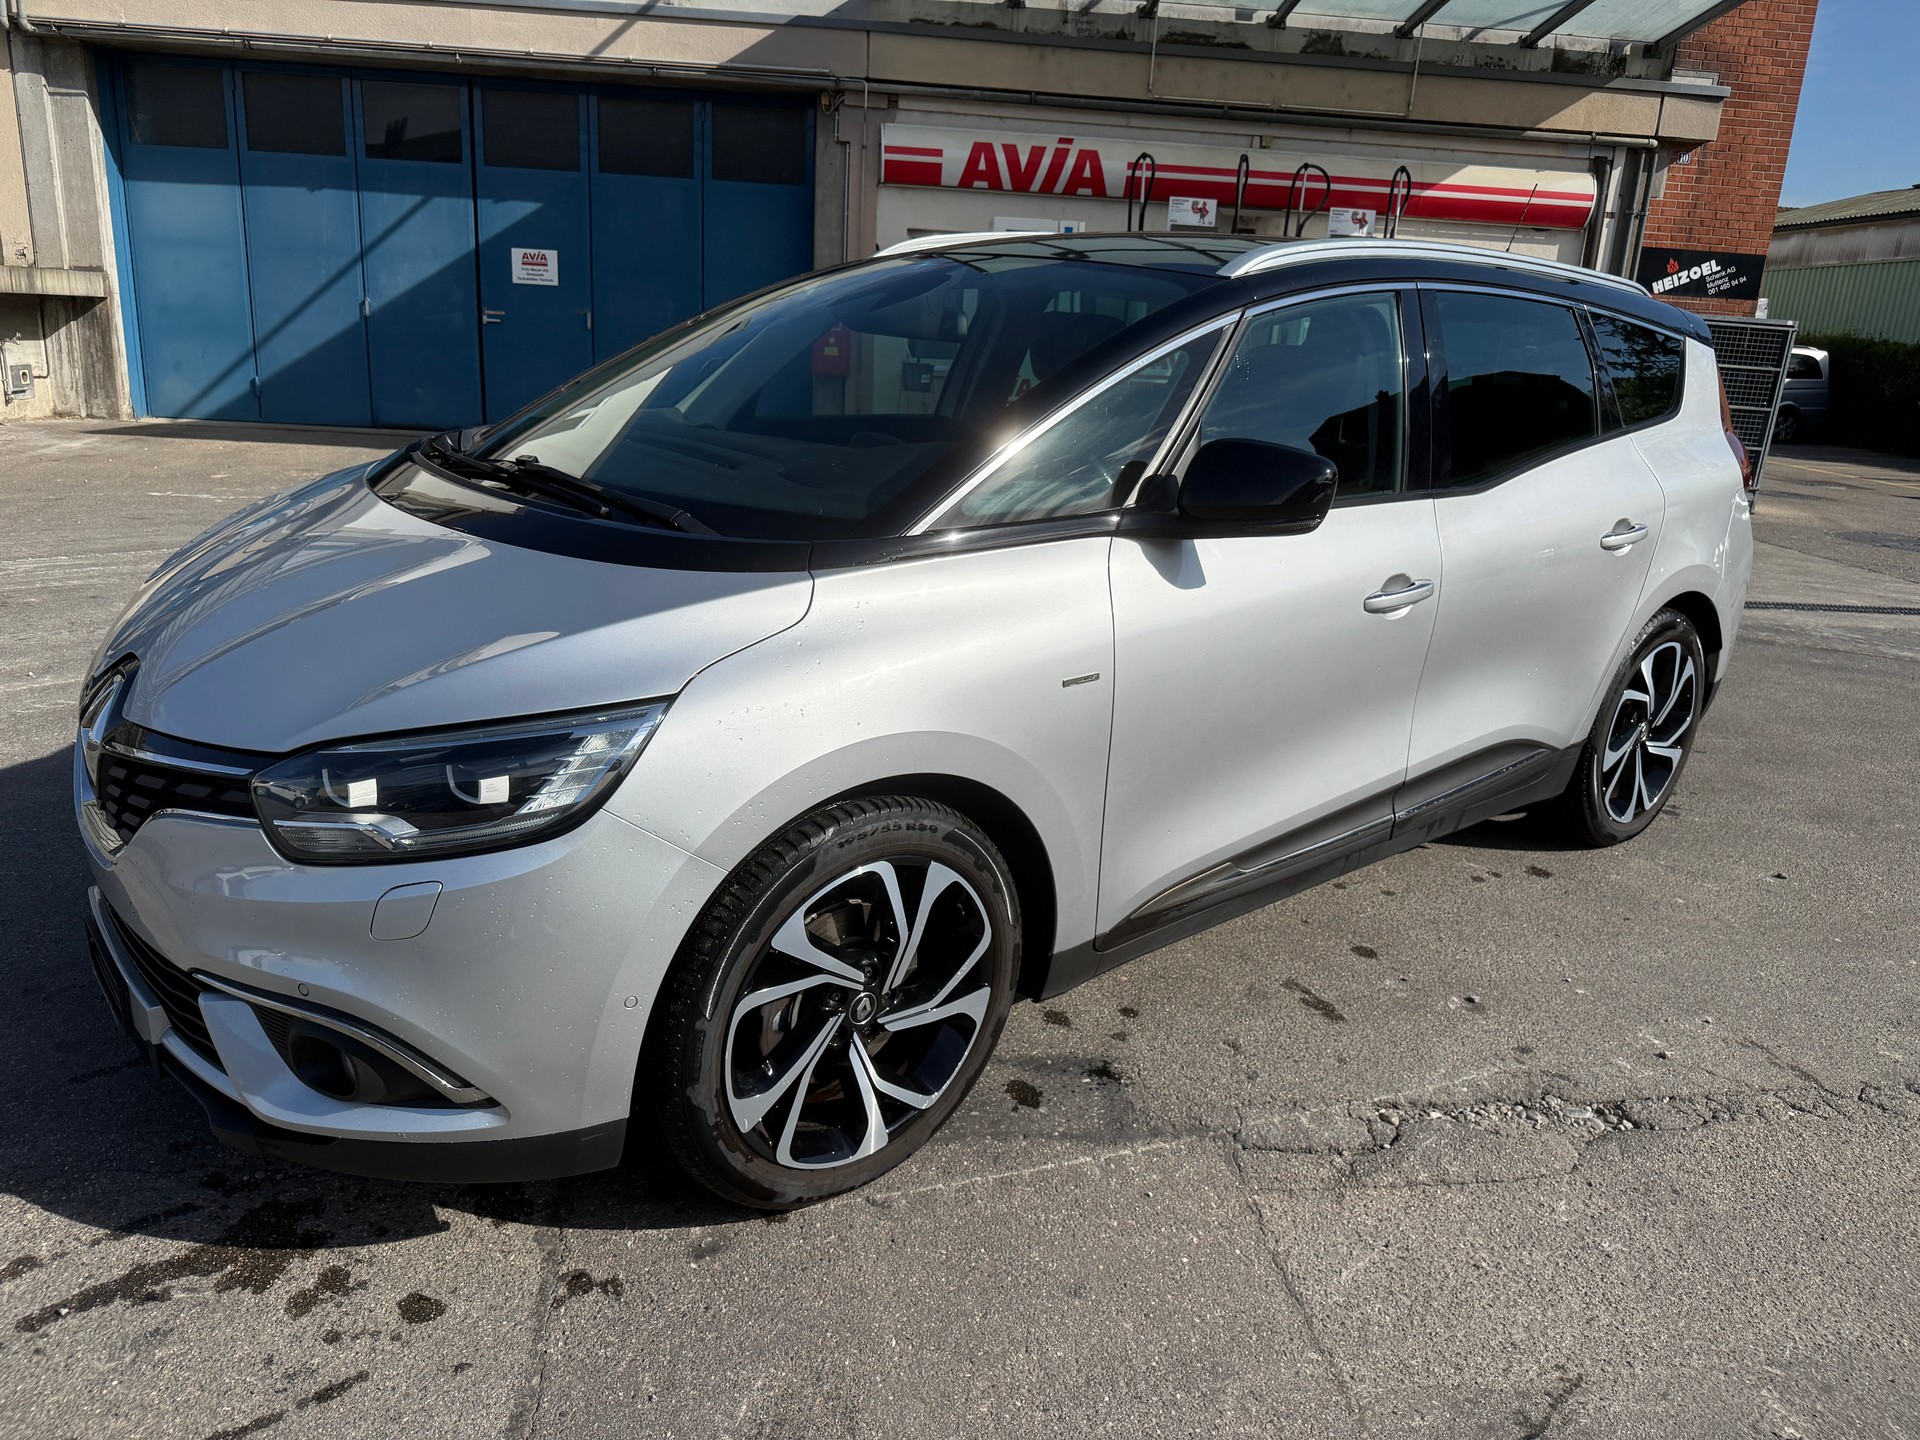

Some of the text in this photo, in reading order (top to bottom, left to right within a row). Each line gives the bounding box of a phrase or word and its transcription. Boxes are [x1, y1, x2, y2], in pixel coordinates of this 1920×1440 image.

[1652, 260, 1721, 294] HEIZOEL
[1705, 266, 1736, 282] Schenk AG
